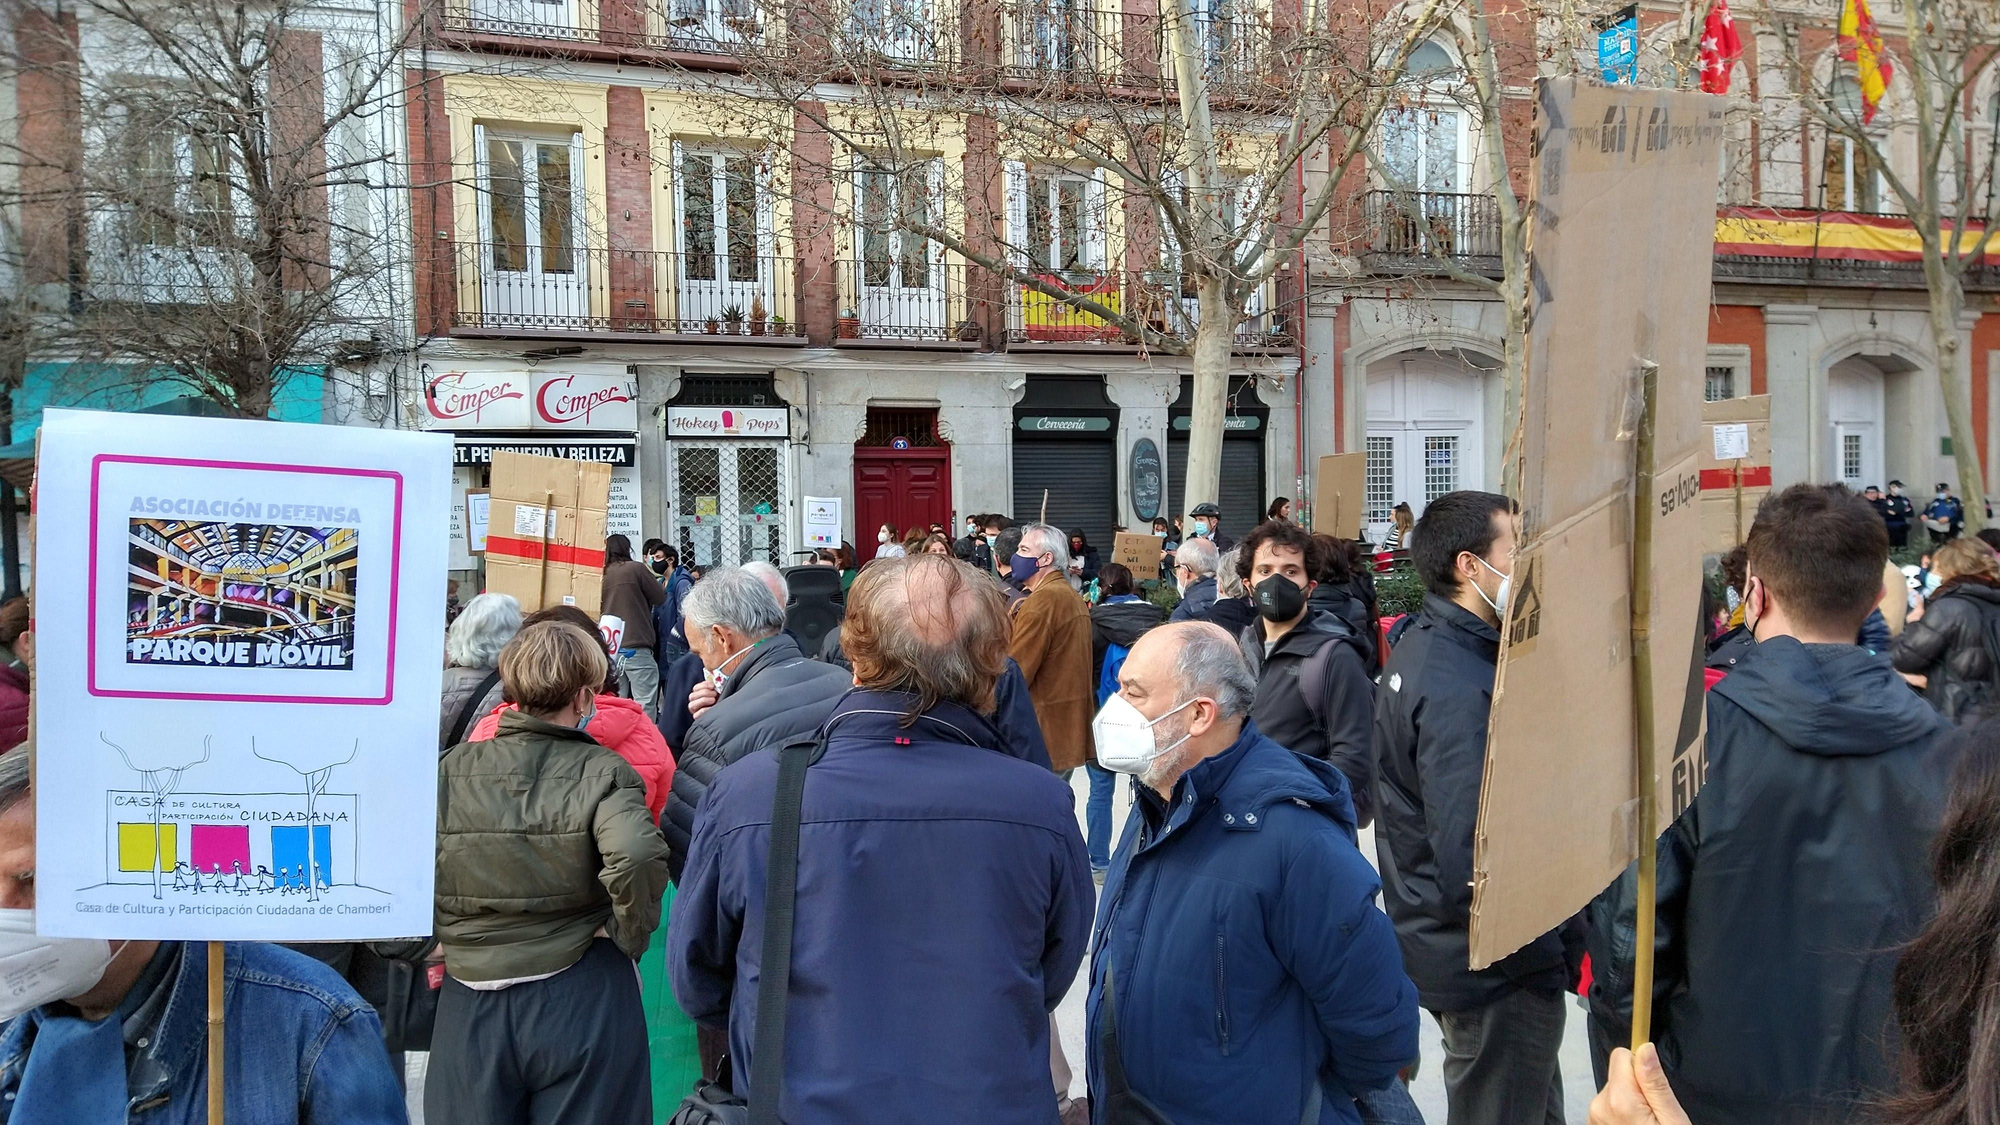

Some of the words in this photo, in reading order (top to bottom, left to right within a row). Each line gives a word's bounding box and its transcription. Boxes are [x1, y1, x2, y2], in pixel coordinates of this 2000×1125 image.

[426, 372, 524, 424] Comper
[536, 375, 629, 425] Comper
[672, 416, 720, 431] Hokey
[747, 418, 779, 431] Pops
[1037, 416, 1086, 430] Cervecería
[471, 447, 554, 463] PELRIA
[569, 447, 626, 463] BELLEZA
[130, 496, 261, 519] ASOCIACIÓN
[267, 503, 361, 523] DEFENSA
[132, 639, 249, 665] PARQUE
[256, 638, 347, 666] MÓVIL
[114, 795, 165, 807] CASA
[191, 801, 241, 809] CULTURA
[162, 812, 234, 821] PARTICIPACIÓN
[240, 810, 349, 823] CIUDADANA
[75, 902, 101, 913] Casa
[105, 902, 119, 914] de
[123, 903, 165, 914] Cultura
[169, 906, 175, 917] y
[179, 903, 252, 917] Participación
[256, 904, 315, 915] Ciudadana
[323, 904, 333, 915] de
[337, 902, 391, 914] Chamberí
